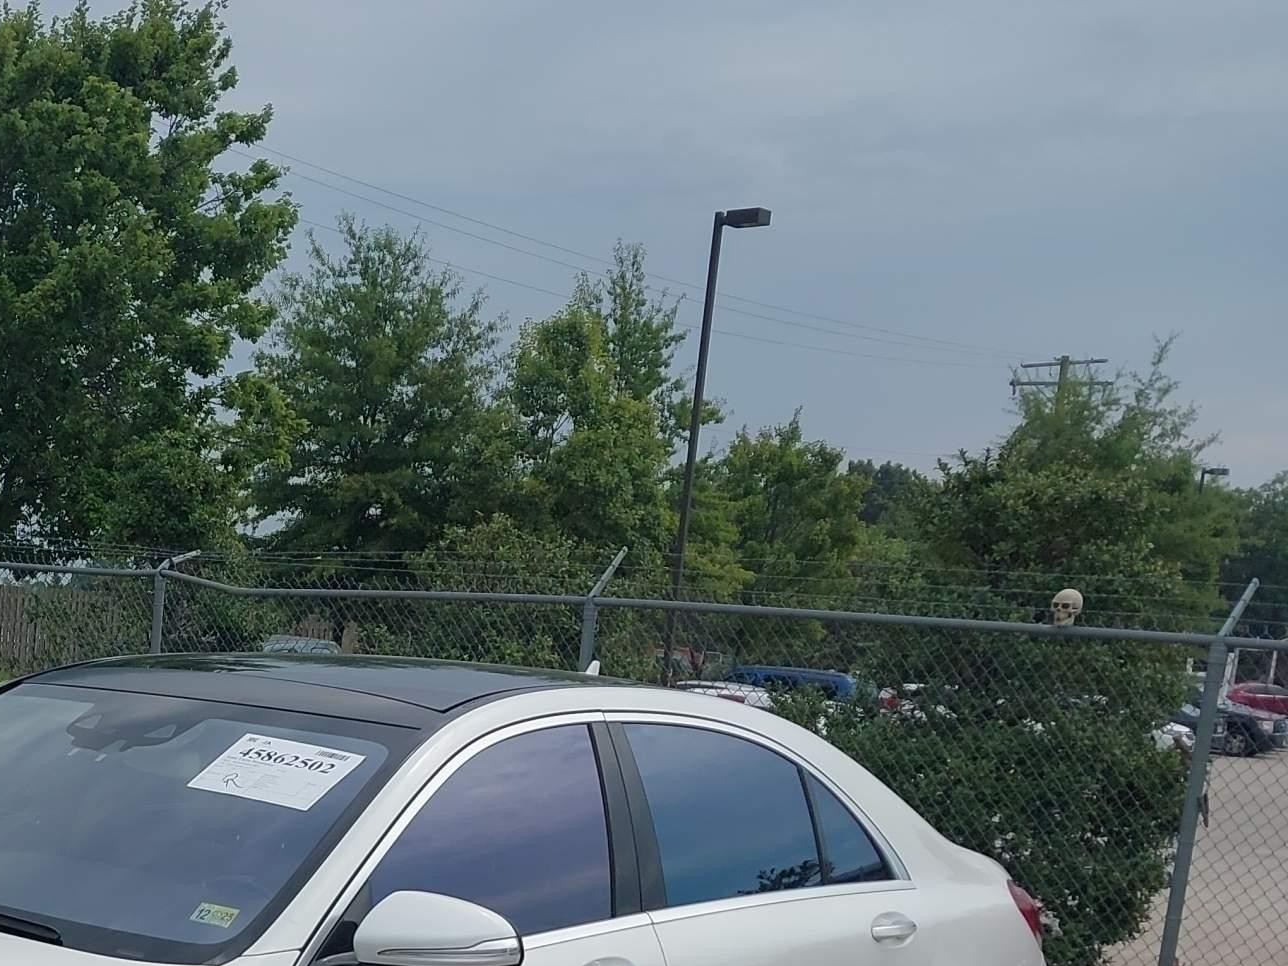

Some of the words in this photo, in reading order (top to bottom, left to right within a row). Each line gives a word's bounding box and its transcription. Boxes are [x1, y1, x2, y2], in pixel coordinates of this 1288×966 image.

[239, 747, 336, 774] 45862502
[195, 907, 211, 920] 12
[221, 912, 234, 921] 25
